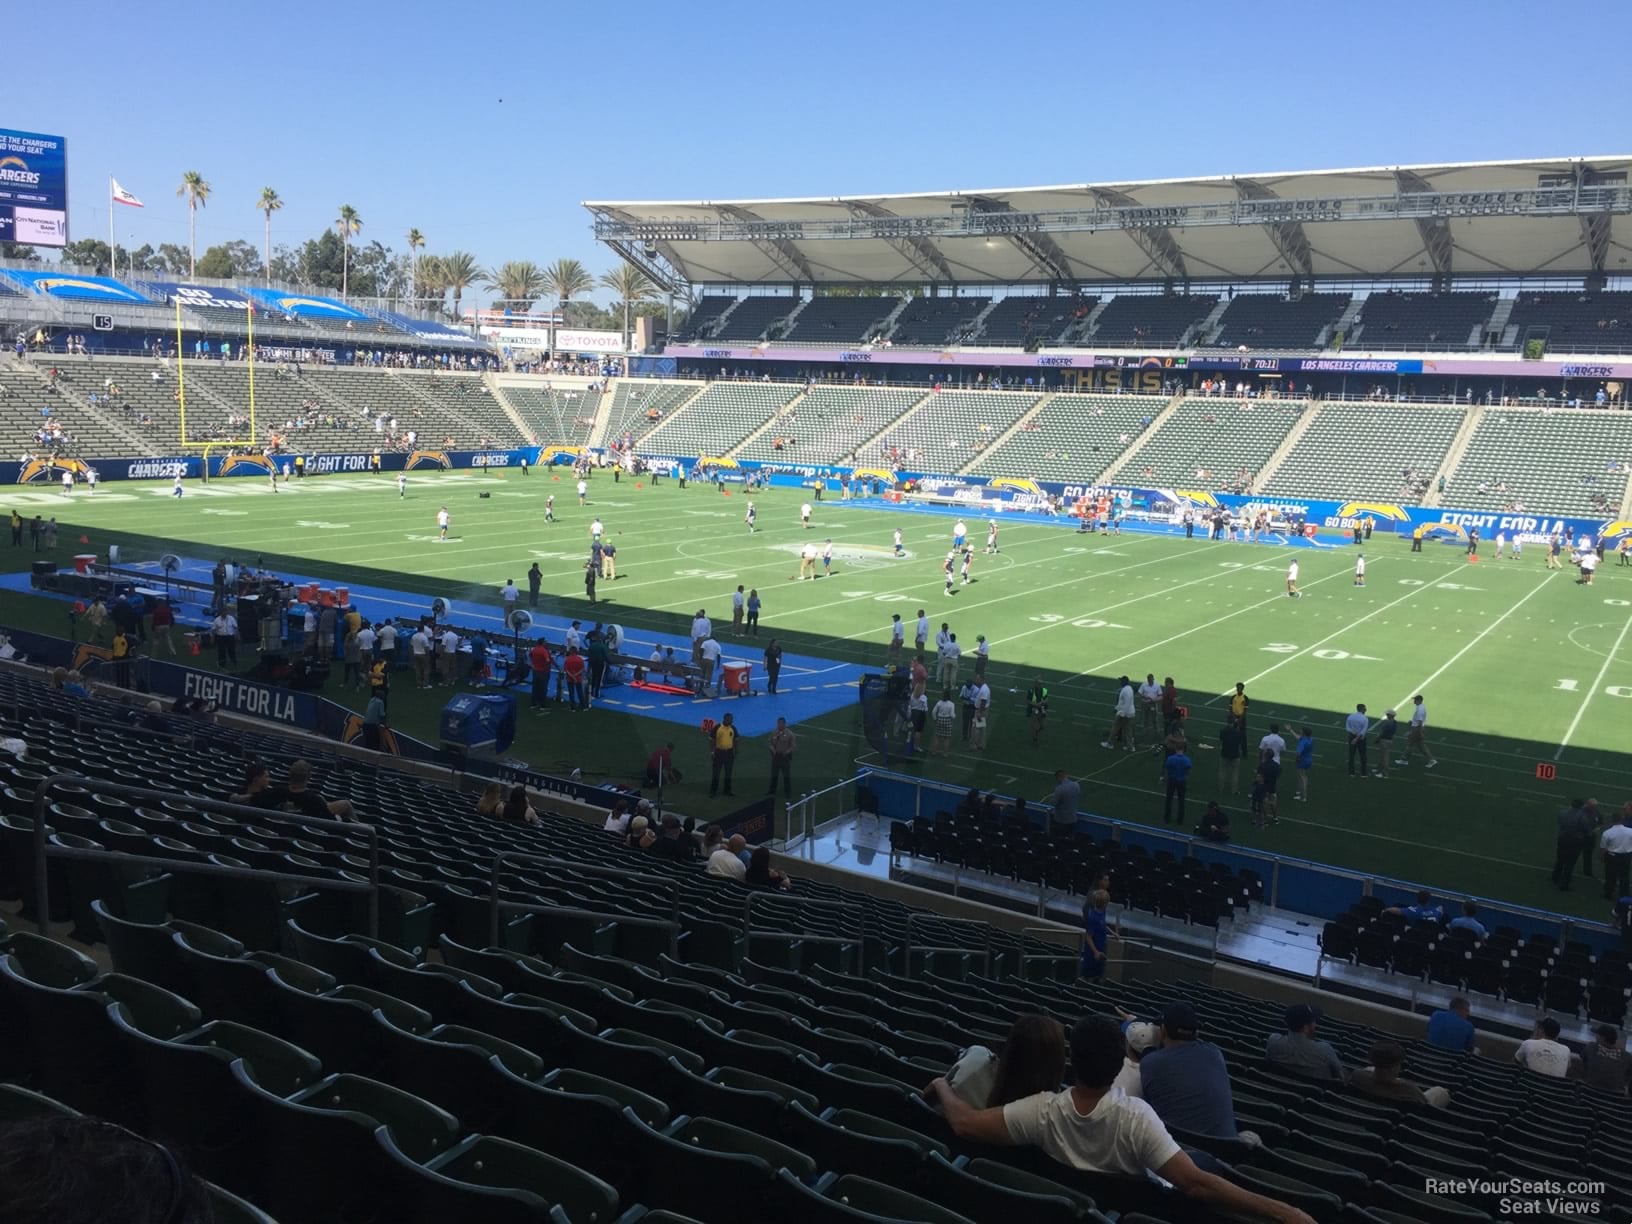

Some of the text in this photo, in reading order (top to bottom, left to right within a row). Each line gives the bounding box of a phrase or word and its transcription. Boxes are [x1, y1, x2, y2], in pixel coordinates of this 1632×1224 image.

[8, 136, 20, 145] THE
[22, 138, 57, 149] CHARGERS
[8, 143, 25, 152] YOUR
[27, 146, 44, 155] SEAT.
[177, 287, 213, 298] GO
[577, 336, 620, 347] TOYOTA
[1118, 357, 1125, 366] 0
[1165, 358, 1172, 368] 0
[1255, 359, 1276, 369] 70:11
[1301, 360, 1398, 371] LOS ANGELES CHARGERS
[1132, 370, 1161, 391] IS
[343, 455, 366, 470] FOR
[128, 463, 188, 478] CHARGERS
[1325, 516, 1339, 527] GO
[738, 671, 748, 684] G
[184, 671, 296, 722] FIGHT FOR LA
[1540, 765, 1554, 779] 10
